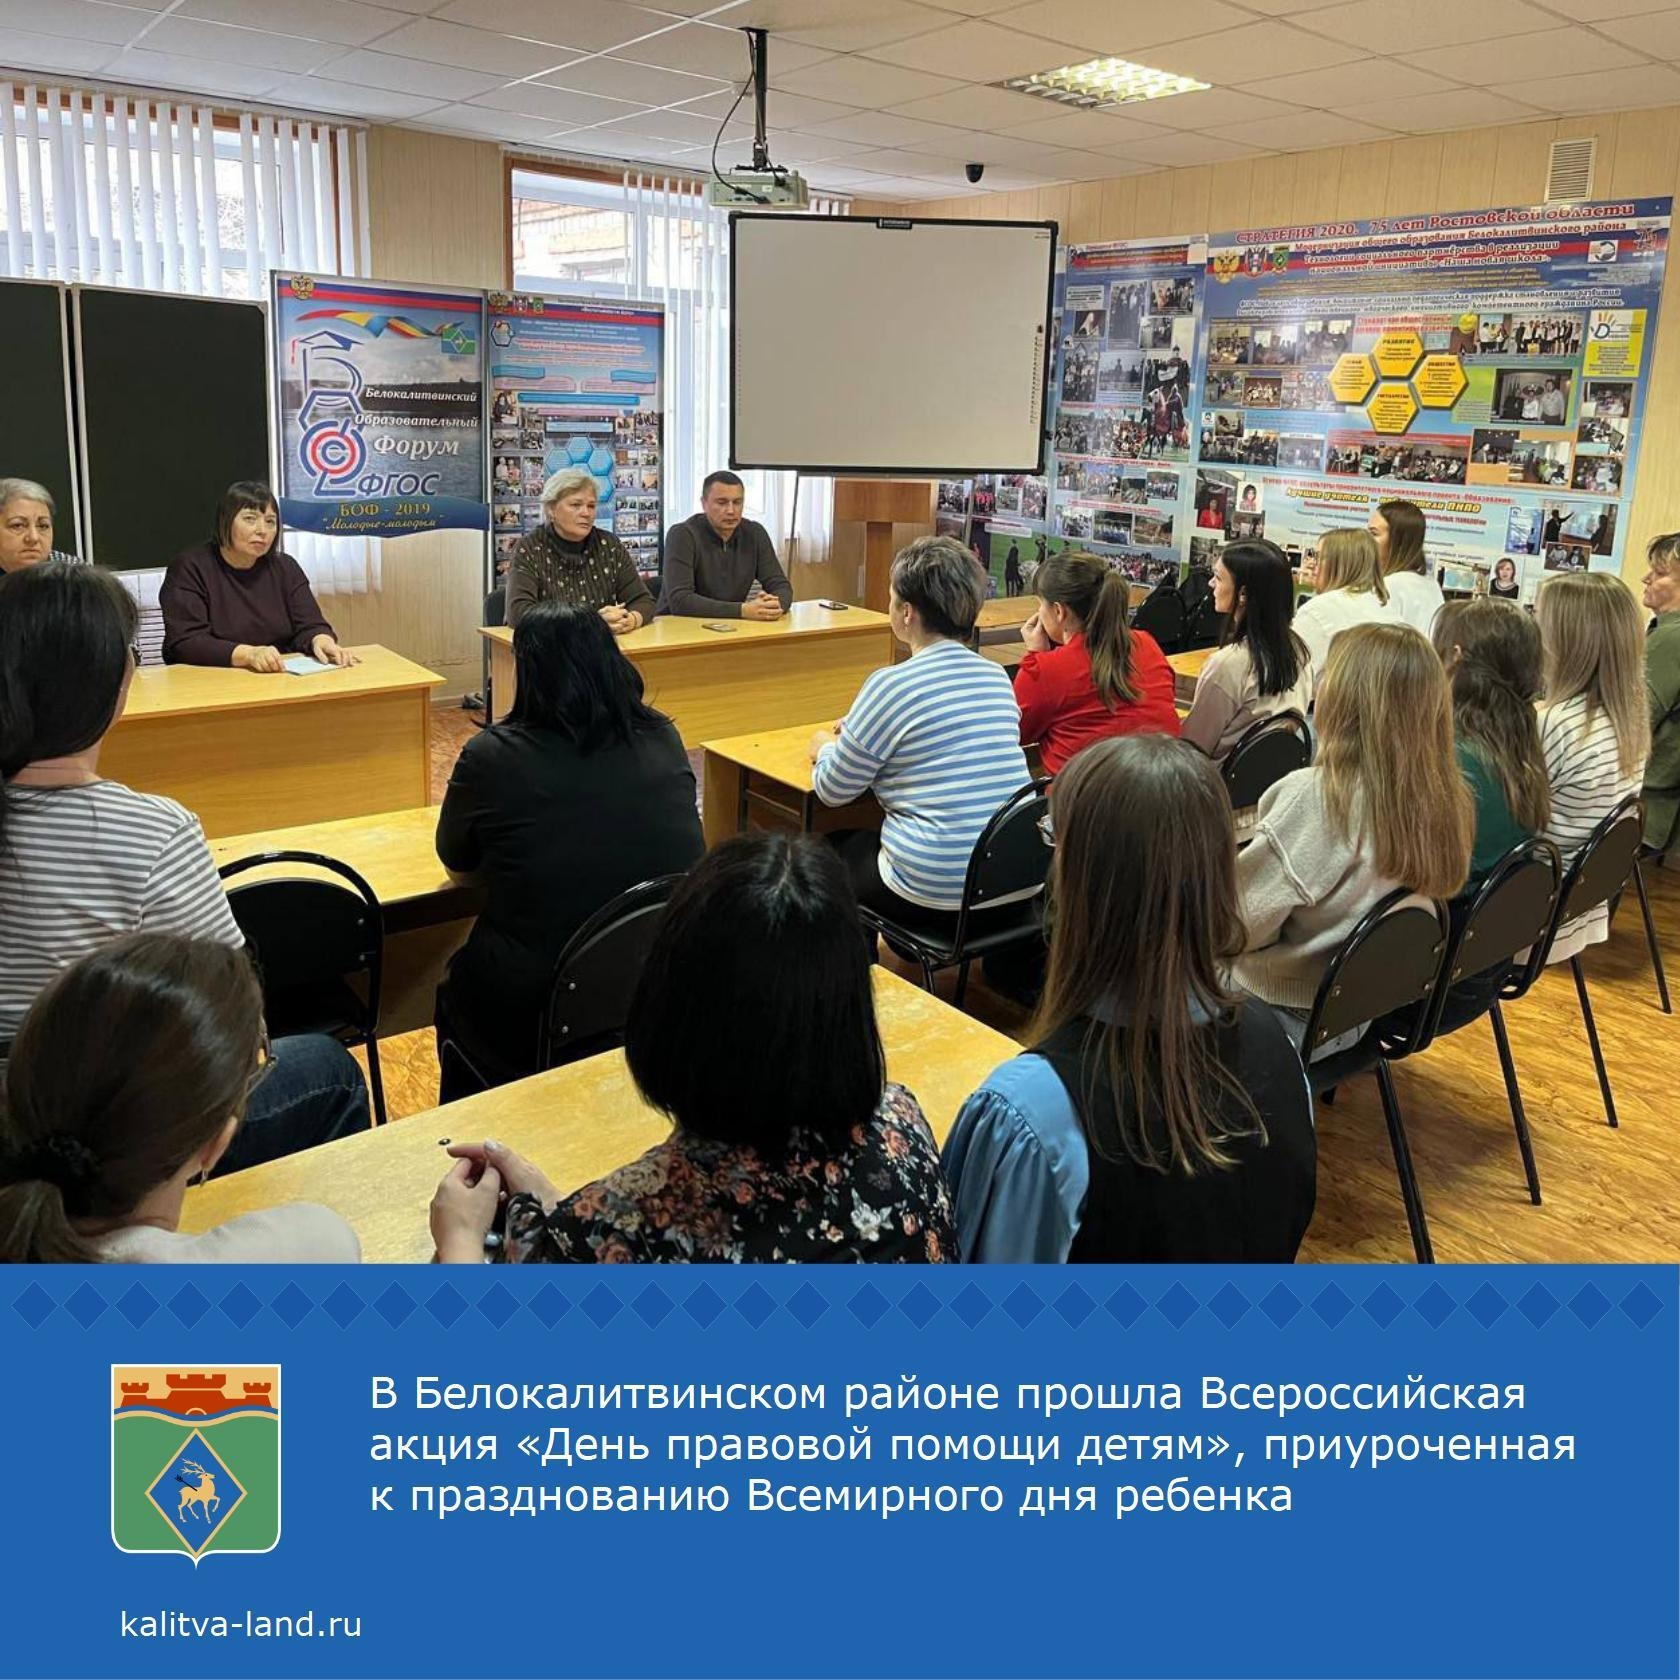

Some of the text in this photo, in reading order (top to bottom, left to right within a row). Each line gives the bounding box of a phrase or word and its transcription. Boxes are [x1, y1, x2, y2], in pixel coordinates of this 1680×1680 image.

[1320, 222, 1358, 237] 2020.
[1369, 220, 1387, 233] 75
[1392, 217, 1424, 231] лет
[1429, 207, 1541, 228] Ростовской
[1546, 204, 1634, 220] области
[1400, 231, 1466, 246] образования
[1468, 223, 1581, 240] Белокалитвинского
[1583, 221, 1627, 236] района
[365, 387, 478, 402] Белокалитвинский
[354, 414, 480, 428] Образовательный
[374, 435, 460, 460] Форум
[358, 472, 440, 497] ФГОС
[339, 503, 380, 517] БОФ
[395, 502, 431, 516] 2019
